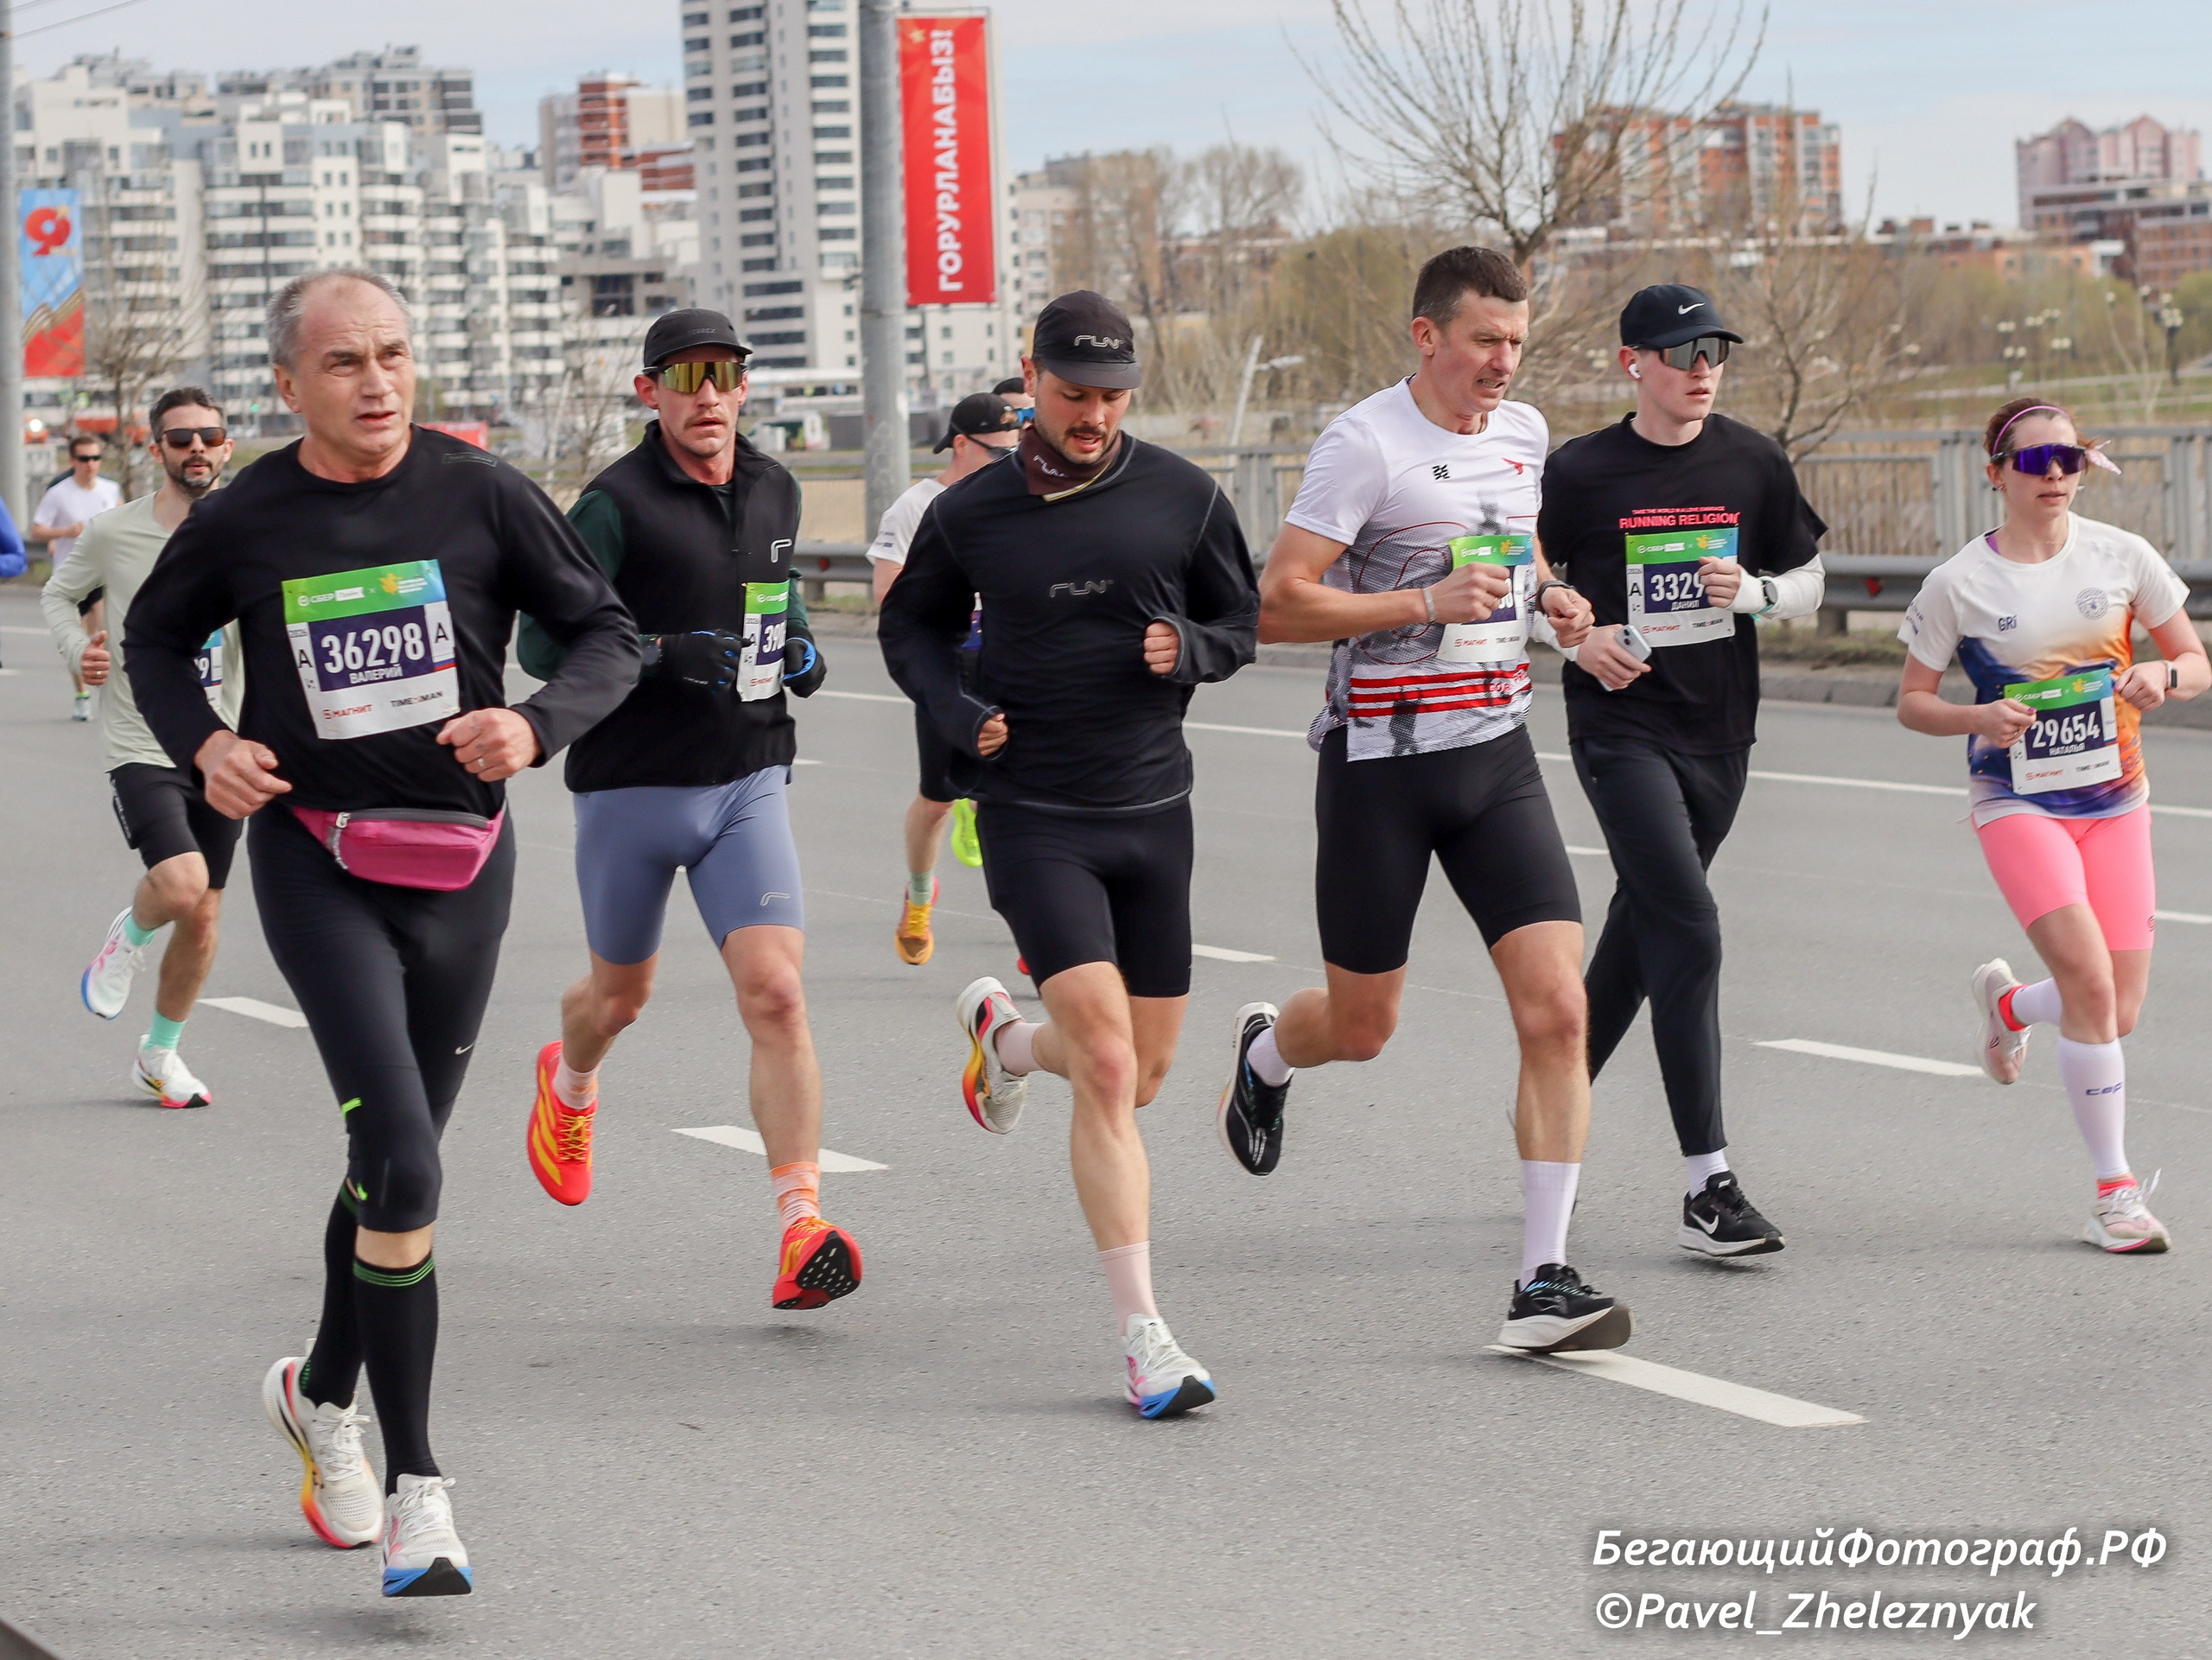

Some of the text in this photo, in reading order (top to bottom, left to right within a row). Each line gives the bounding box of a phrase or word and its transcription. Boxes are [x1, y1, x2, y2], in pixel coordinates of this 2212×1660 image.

[930, 29, 964, 292] ГОРУРЛАНАБЫЗ!
[1619, 512, 1740, 529] RUNNING RELIGION
[1650, 571, 1706, 602] 3329
[321, 622, 426, 674] 36298
[349, 664, 403, 684] ВАЛЕРИЙ
[333, 704, 372, 719] МАГНИТ
[2031, 710, 2101, 748] 29654
